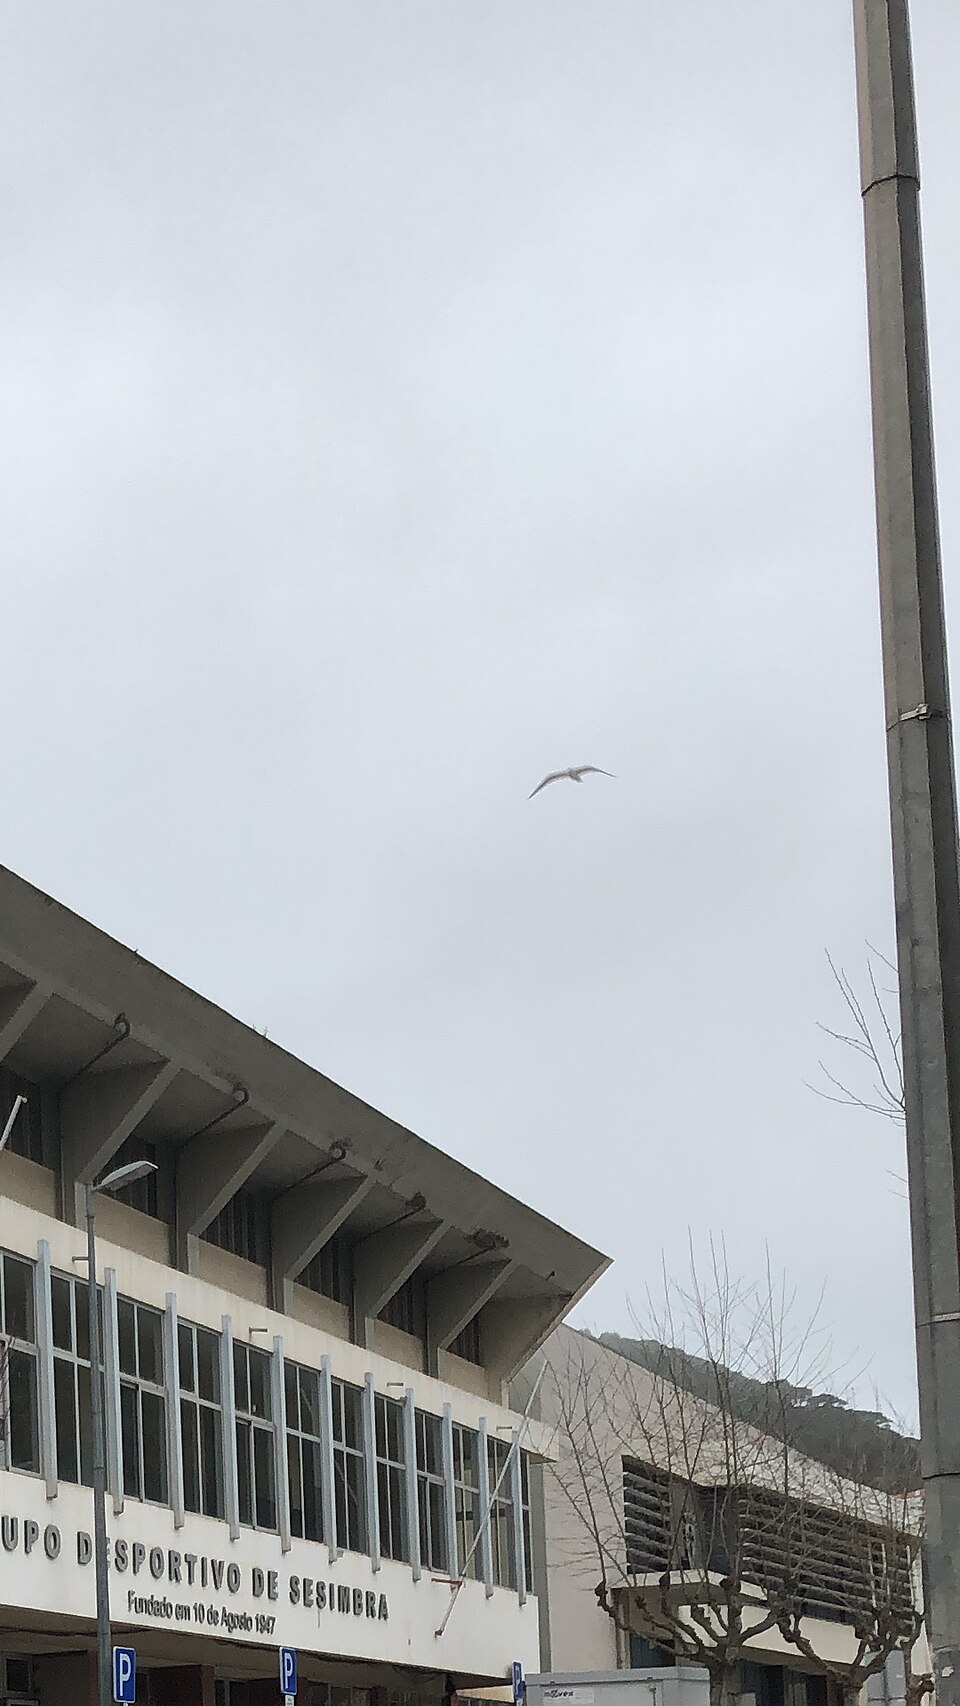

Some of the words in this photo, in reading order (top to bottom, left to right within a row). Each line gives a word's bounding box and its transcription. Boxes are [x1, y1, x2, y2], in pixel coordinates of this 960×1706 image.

[127, 1590, 174, 1619] Fundado
[175, 1602, 191, 1621] em
[193, 1602, 205, 1624] 10
[207, 1604, 220, 1626] de
[220, 1606, 253, 1634] Agosto
[255, 1613, 276, 1635] 1947
[252, 1567, 279, 1600] DE
[289, 1575, 390, 1621] SESIMBRA
[119, 1653, 132, 1697] P
[284, 1652, 293, 1689] P
